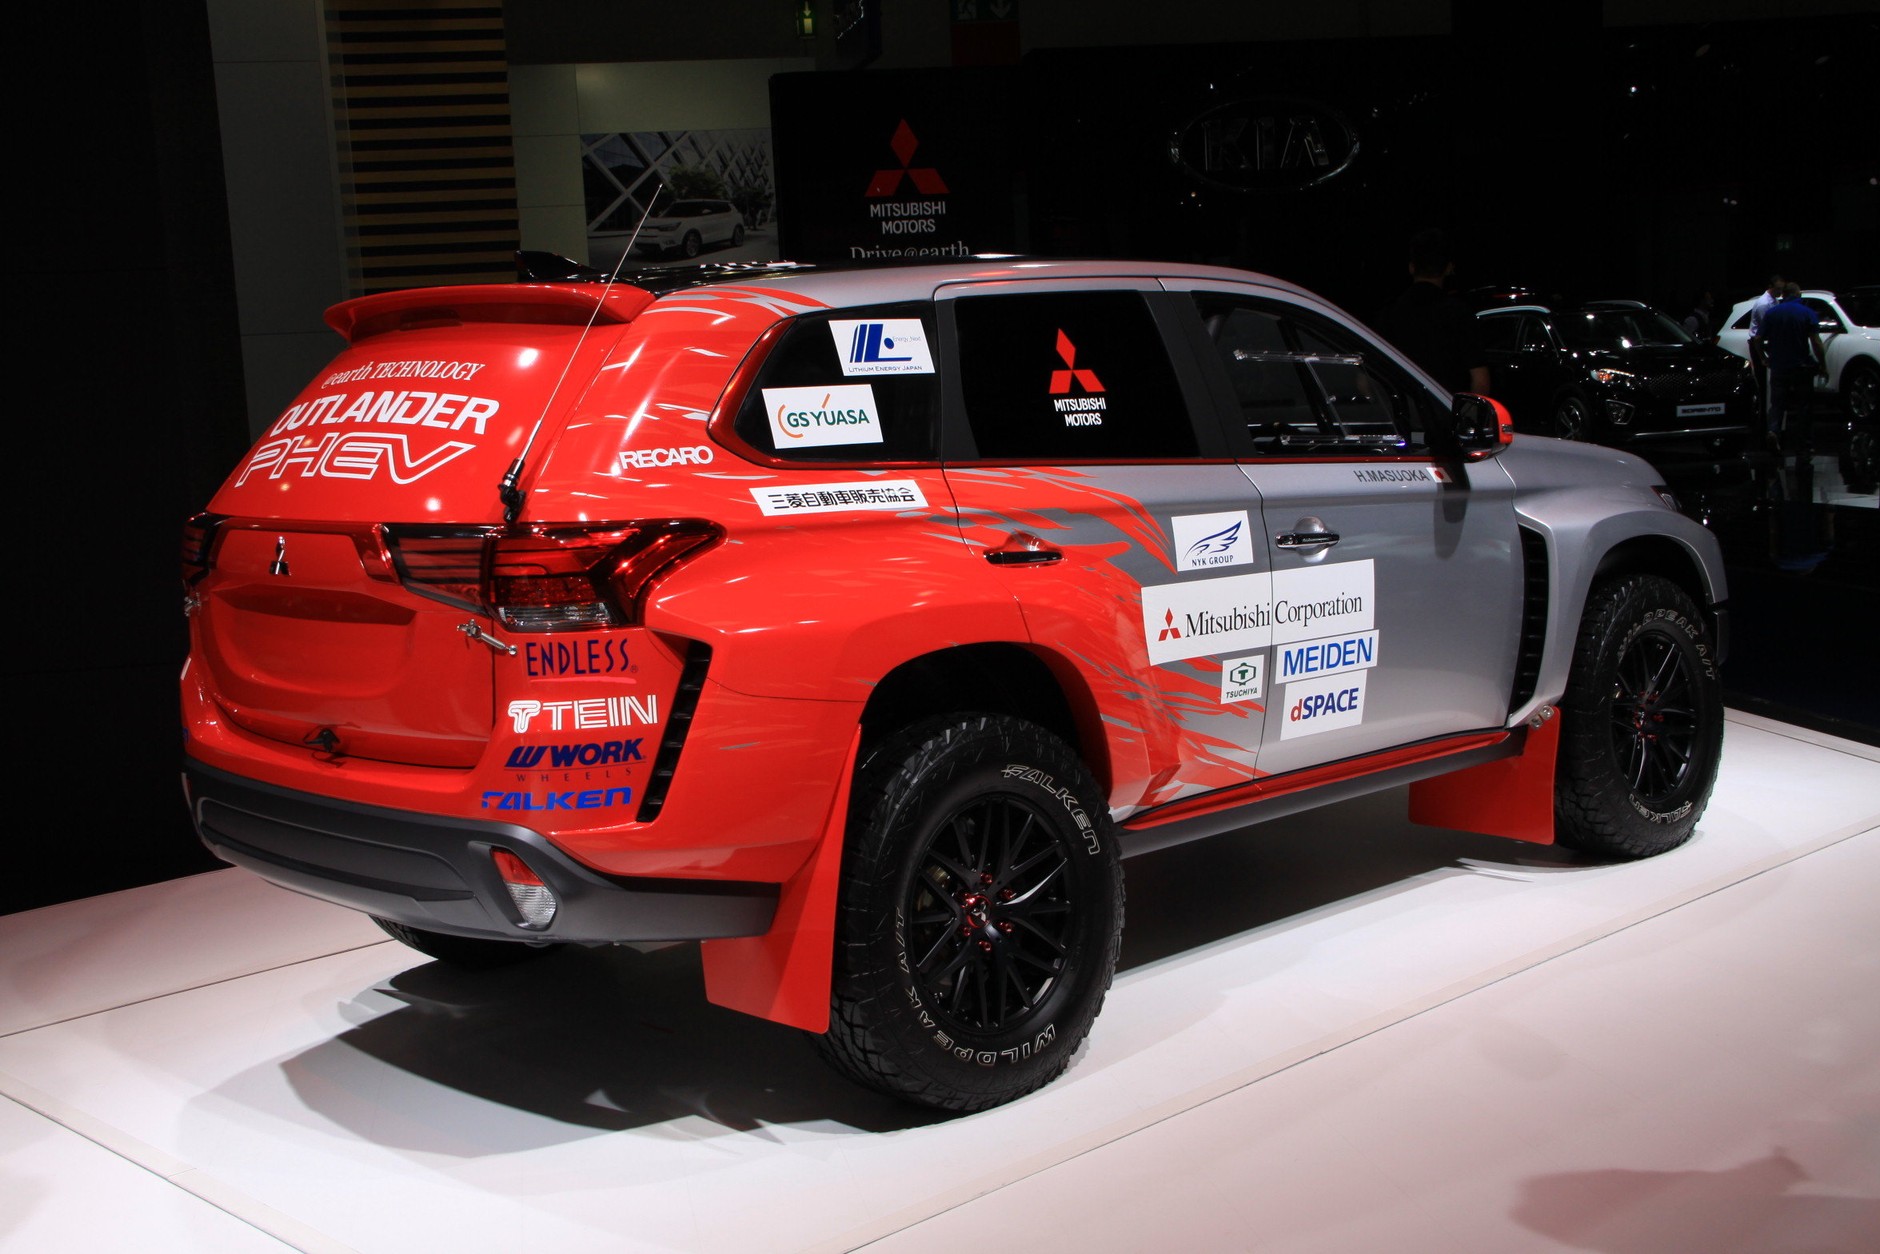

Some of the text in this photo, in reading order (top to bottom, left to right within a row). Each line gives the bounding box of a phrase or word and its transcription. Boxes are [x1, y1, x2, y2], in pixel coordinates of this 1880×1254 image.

[870, 201, 946, 217] MITSUBISHI
[881, 218, 936, 235] MOTORS
[320, 360, 486, 389] @earth TECHNOLOGY
[270, 390, 500, 435] OUTLANDER
[1053, 397, 1107, 412] MITSUBISHI
[1064, 413, 1103, 427] MOTORS
[234, 431, 477, 487] PHEV
[619, 445, 714, 470] RECARO
[1355, 470, 1429, 483] H.MASUOKA
[767, 487, 916, 509] 三菱自動車販売協会
[1191, 555, 1235, 567] NYK GROUP
[1185, 592, 1363, 638] Mitsubishi Corporation
[526, 638, 629, 676] ENDLESS
[1283, 636, 1373, 677] MEIDEN
[1226, 687, 1258, 699] TSUCHIYA
[1290, 687, 1360, 722] dSPACE
[481, 786, 633, 811] FALKEN
[1002, 763, 1101, 855] FALKEN
[904, 986, 1056, 1066] WILDPEAK
